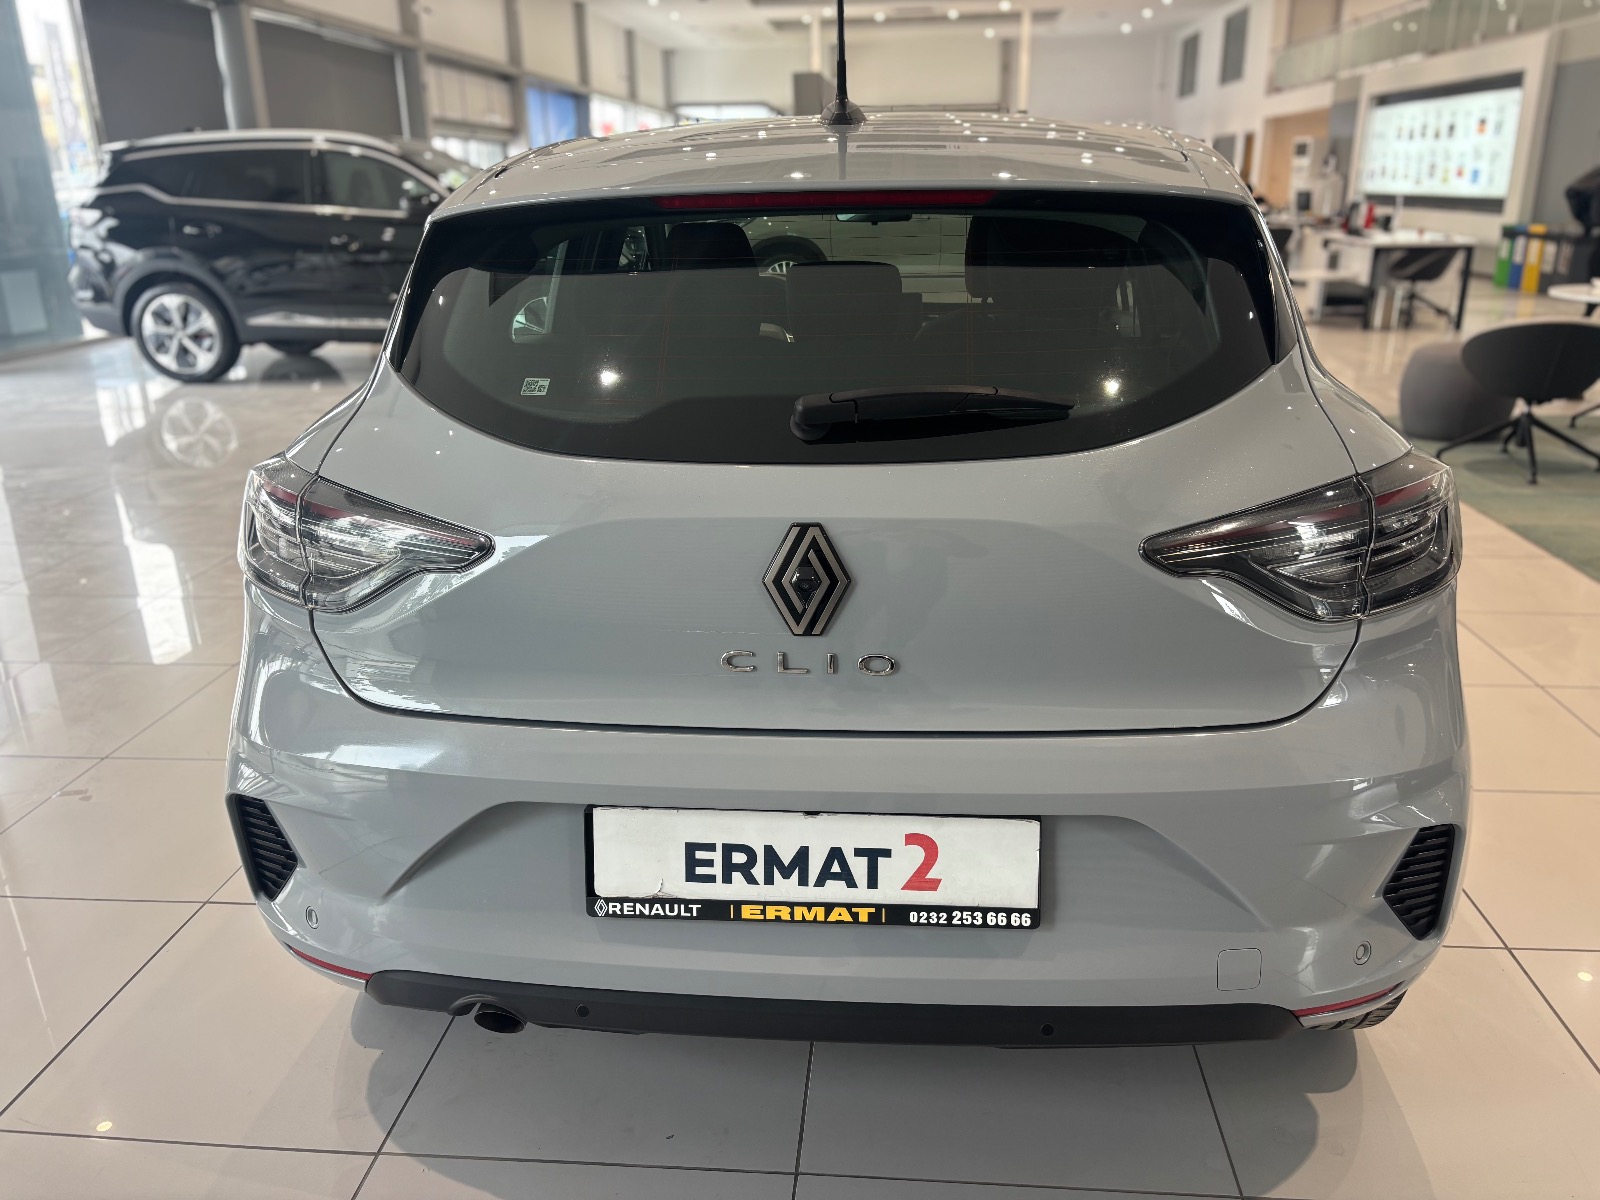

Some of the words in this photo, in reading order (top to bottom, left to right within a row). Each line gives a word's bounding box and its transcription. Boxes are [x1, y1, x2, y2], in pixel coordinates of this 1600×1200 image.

[720, 650, 896, 676] CLIO
[684, 841, 892, 890] ERMAT
[900, 832, 943, 892] 2
[608, 902, 702, 917] RENAULT
[740, 904, 876, 923] ERMAT
[909, 911, 948, 924] 0232
[951, 911, 983, 925] 253
[986, 912, 1007, 926] 66
[1010, 912, 1031, 927] 66
